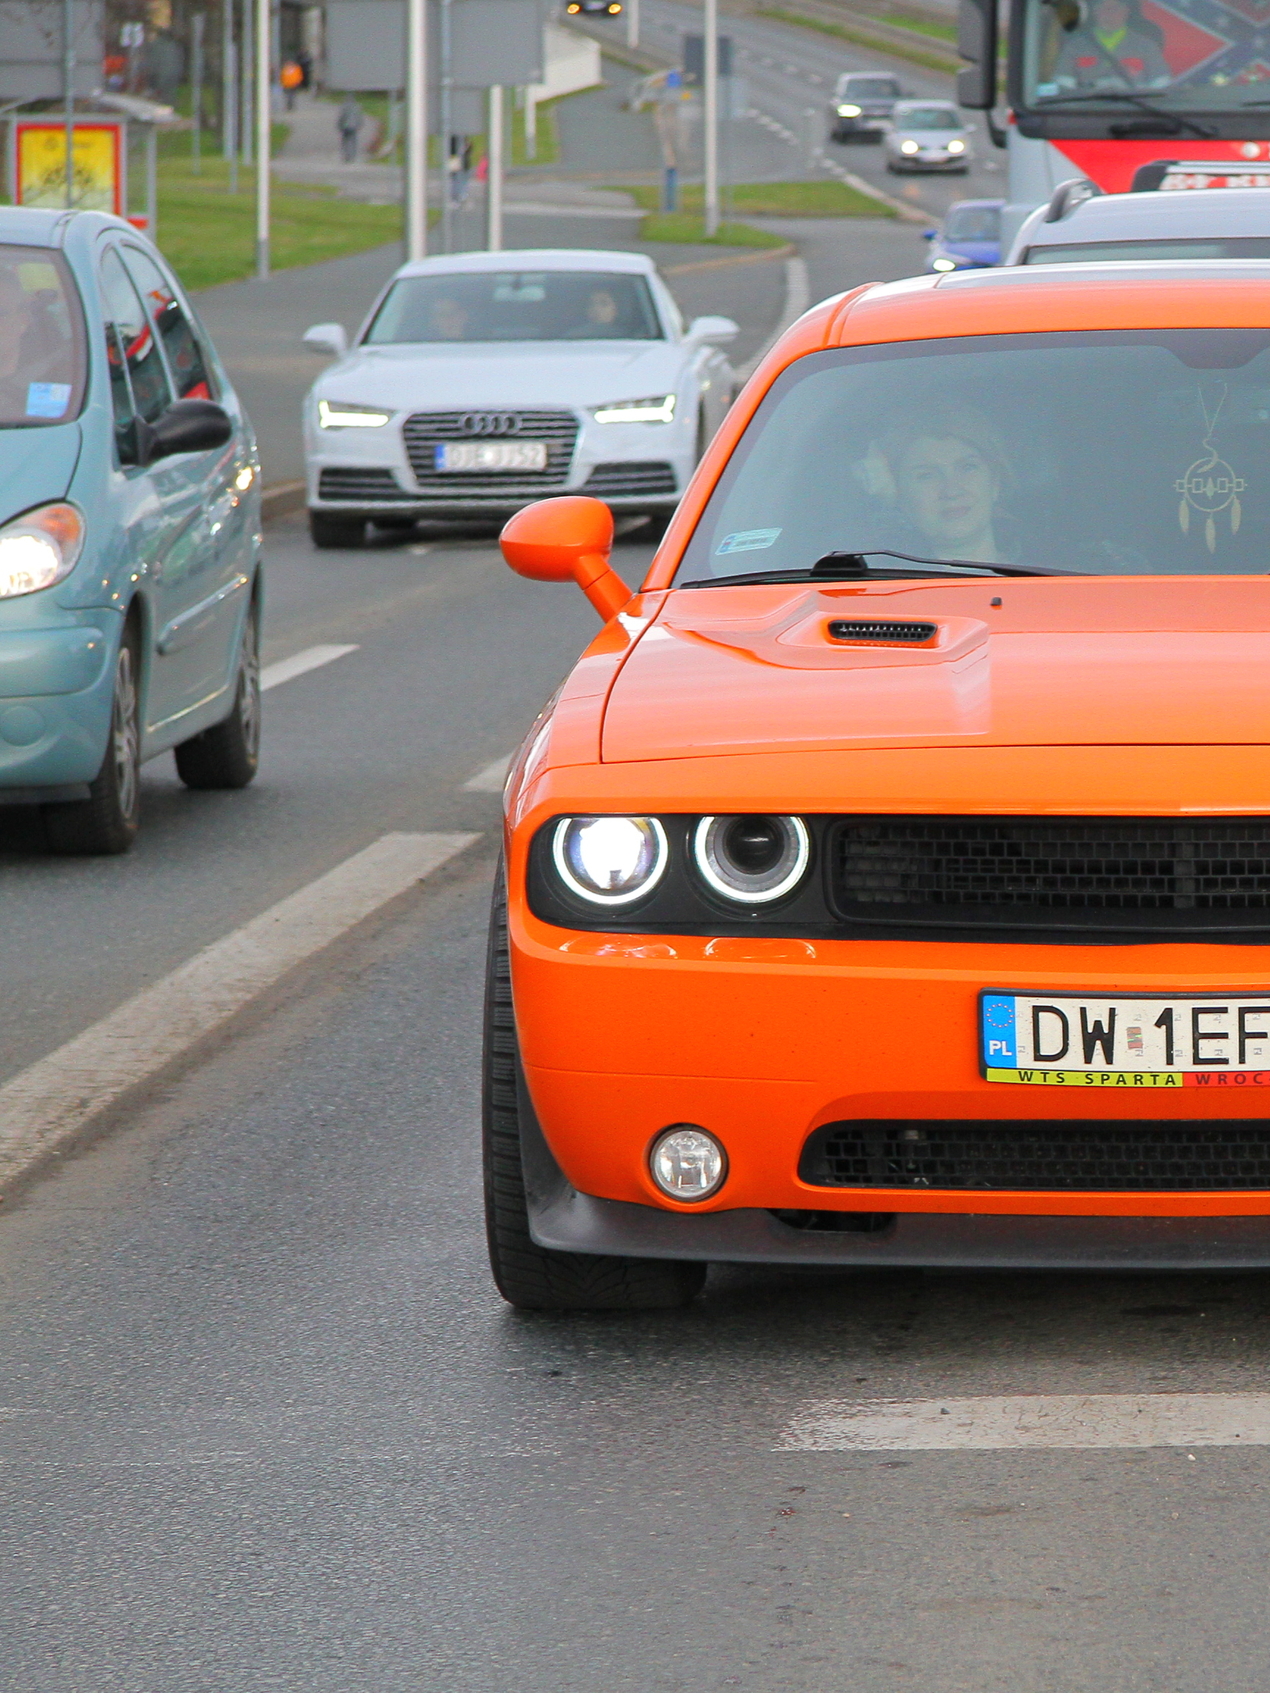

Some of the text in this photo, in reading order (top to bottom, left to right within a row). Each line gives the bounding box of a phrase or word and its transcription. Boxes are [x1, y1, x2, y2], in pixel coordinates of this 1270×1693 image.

[1032, 1005, 1116, 1065] DW
[988, 1040, 1013, 1056] PL
[1018, 1070, 1066, 1084] WTS
[1085, 1073, 1177, 1086] SPARTA
